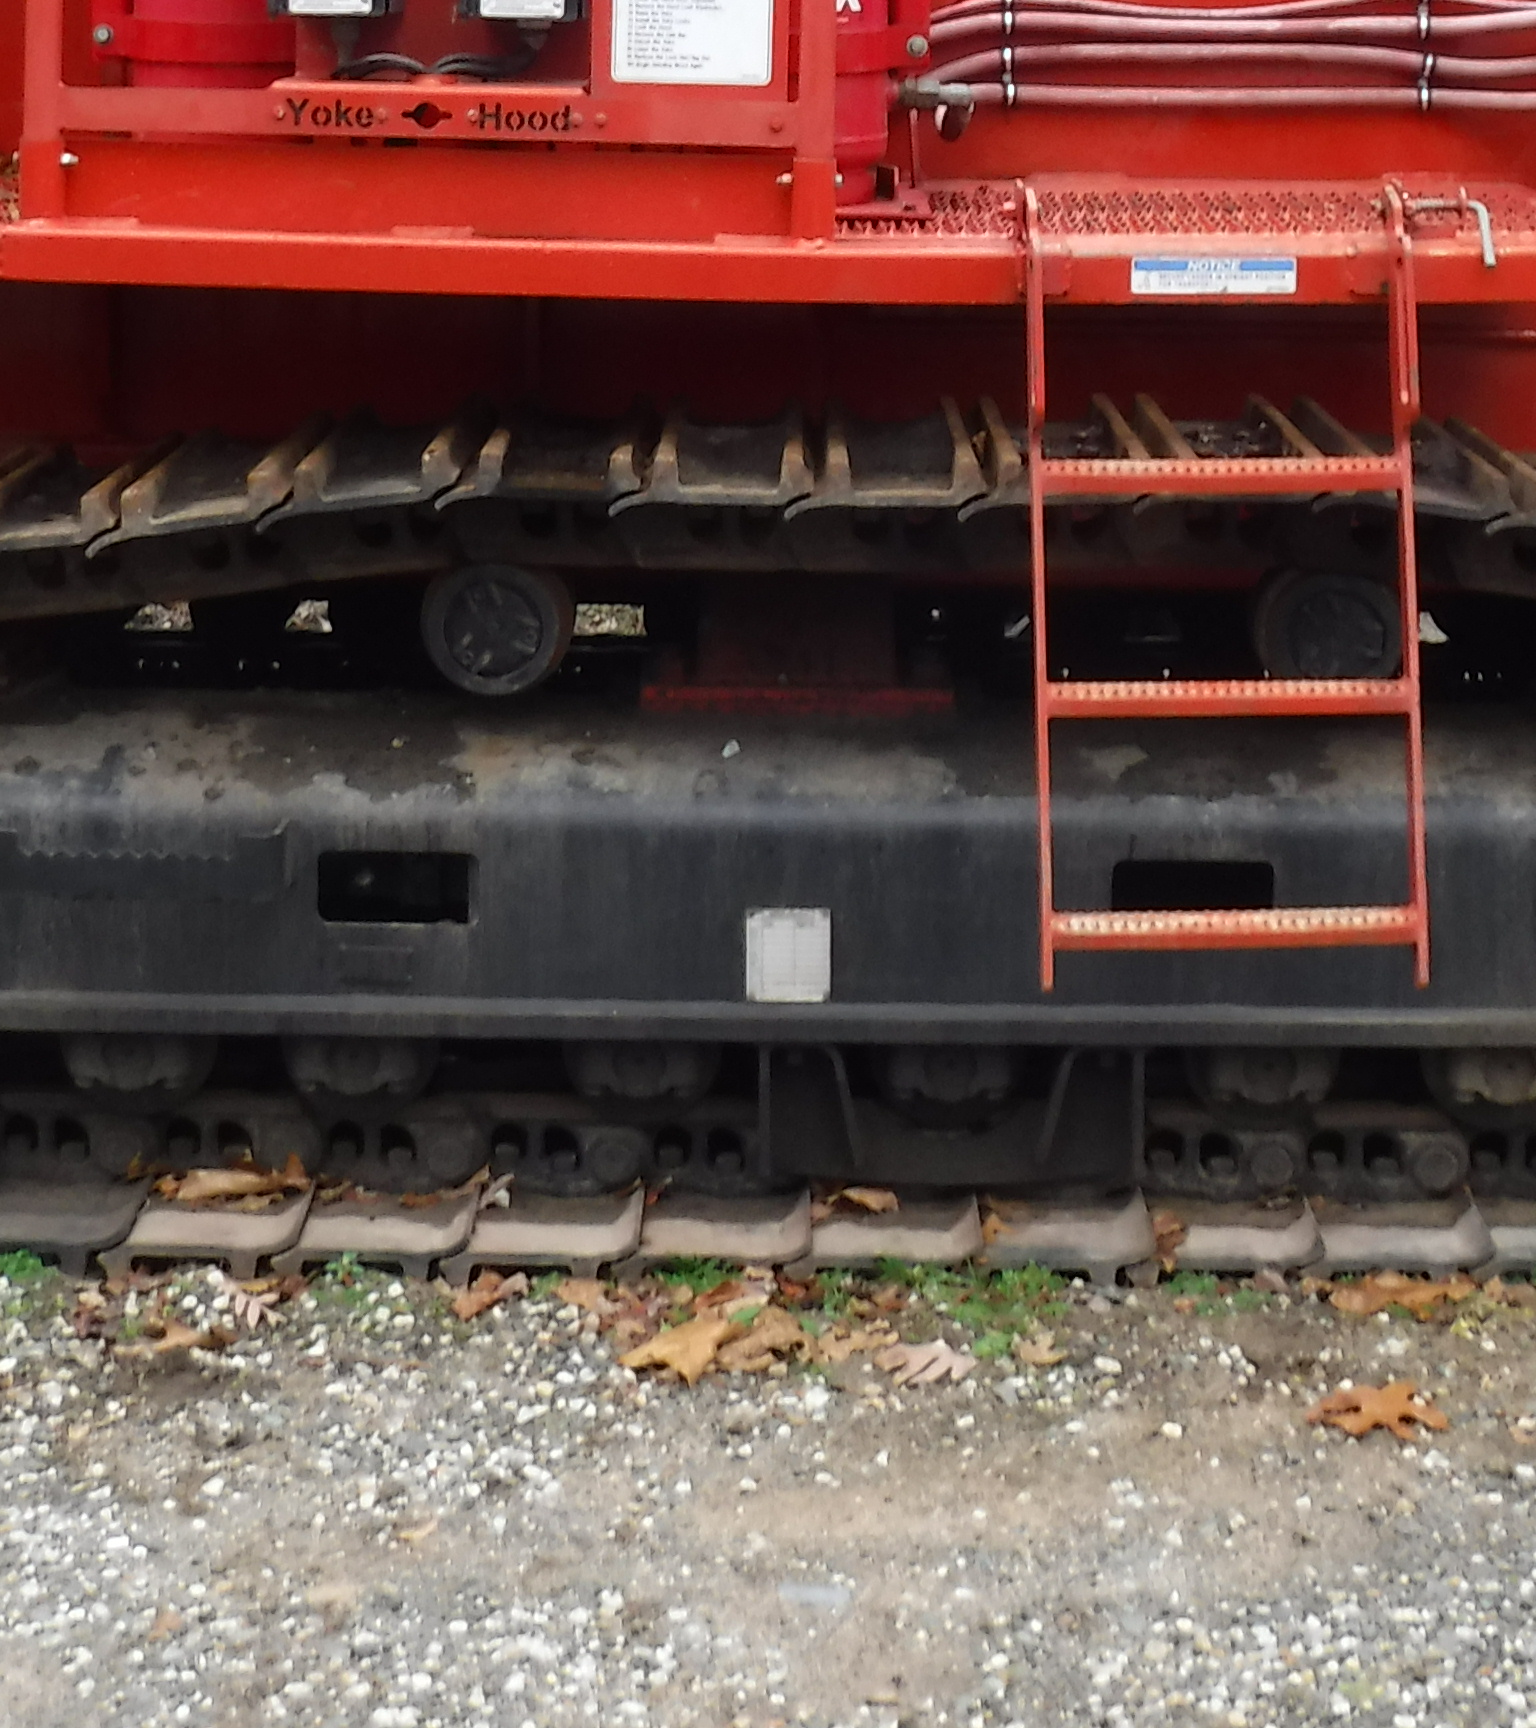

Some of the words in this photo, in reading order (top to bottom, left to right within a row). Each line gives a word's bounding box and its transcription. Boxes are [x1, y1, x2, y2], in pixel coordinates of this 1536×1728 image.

[286, 97, 374, 128] Yoke
[478, 102, 571, 132] Hood
[1186, 259, 1240, 272] NOTICE
